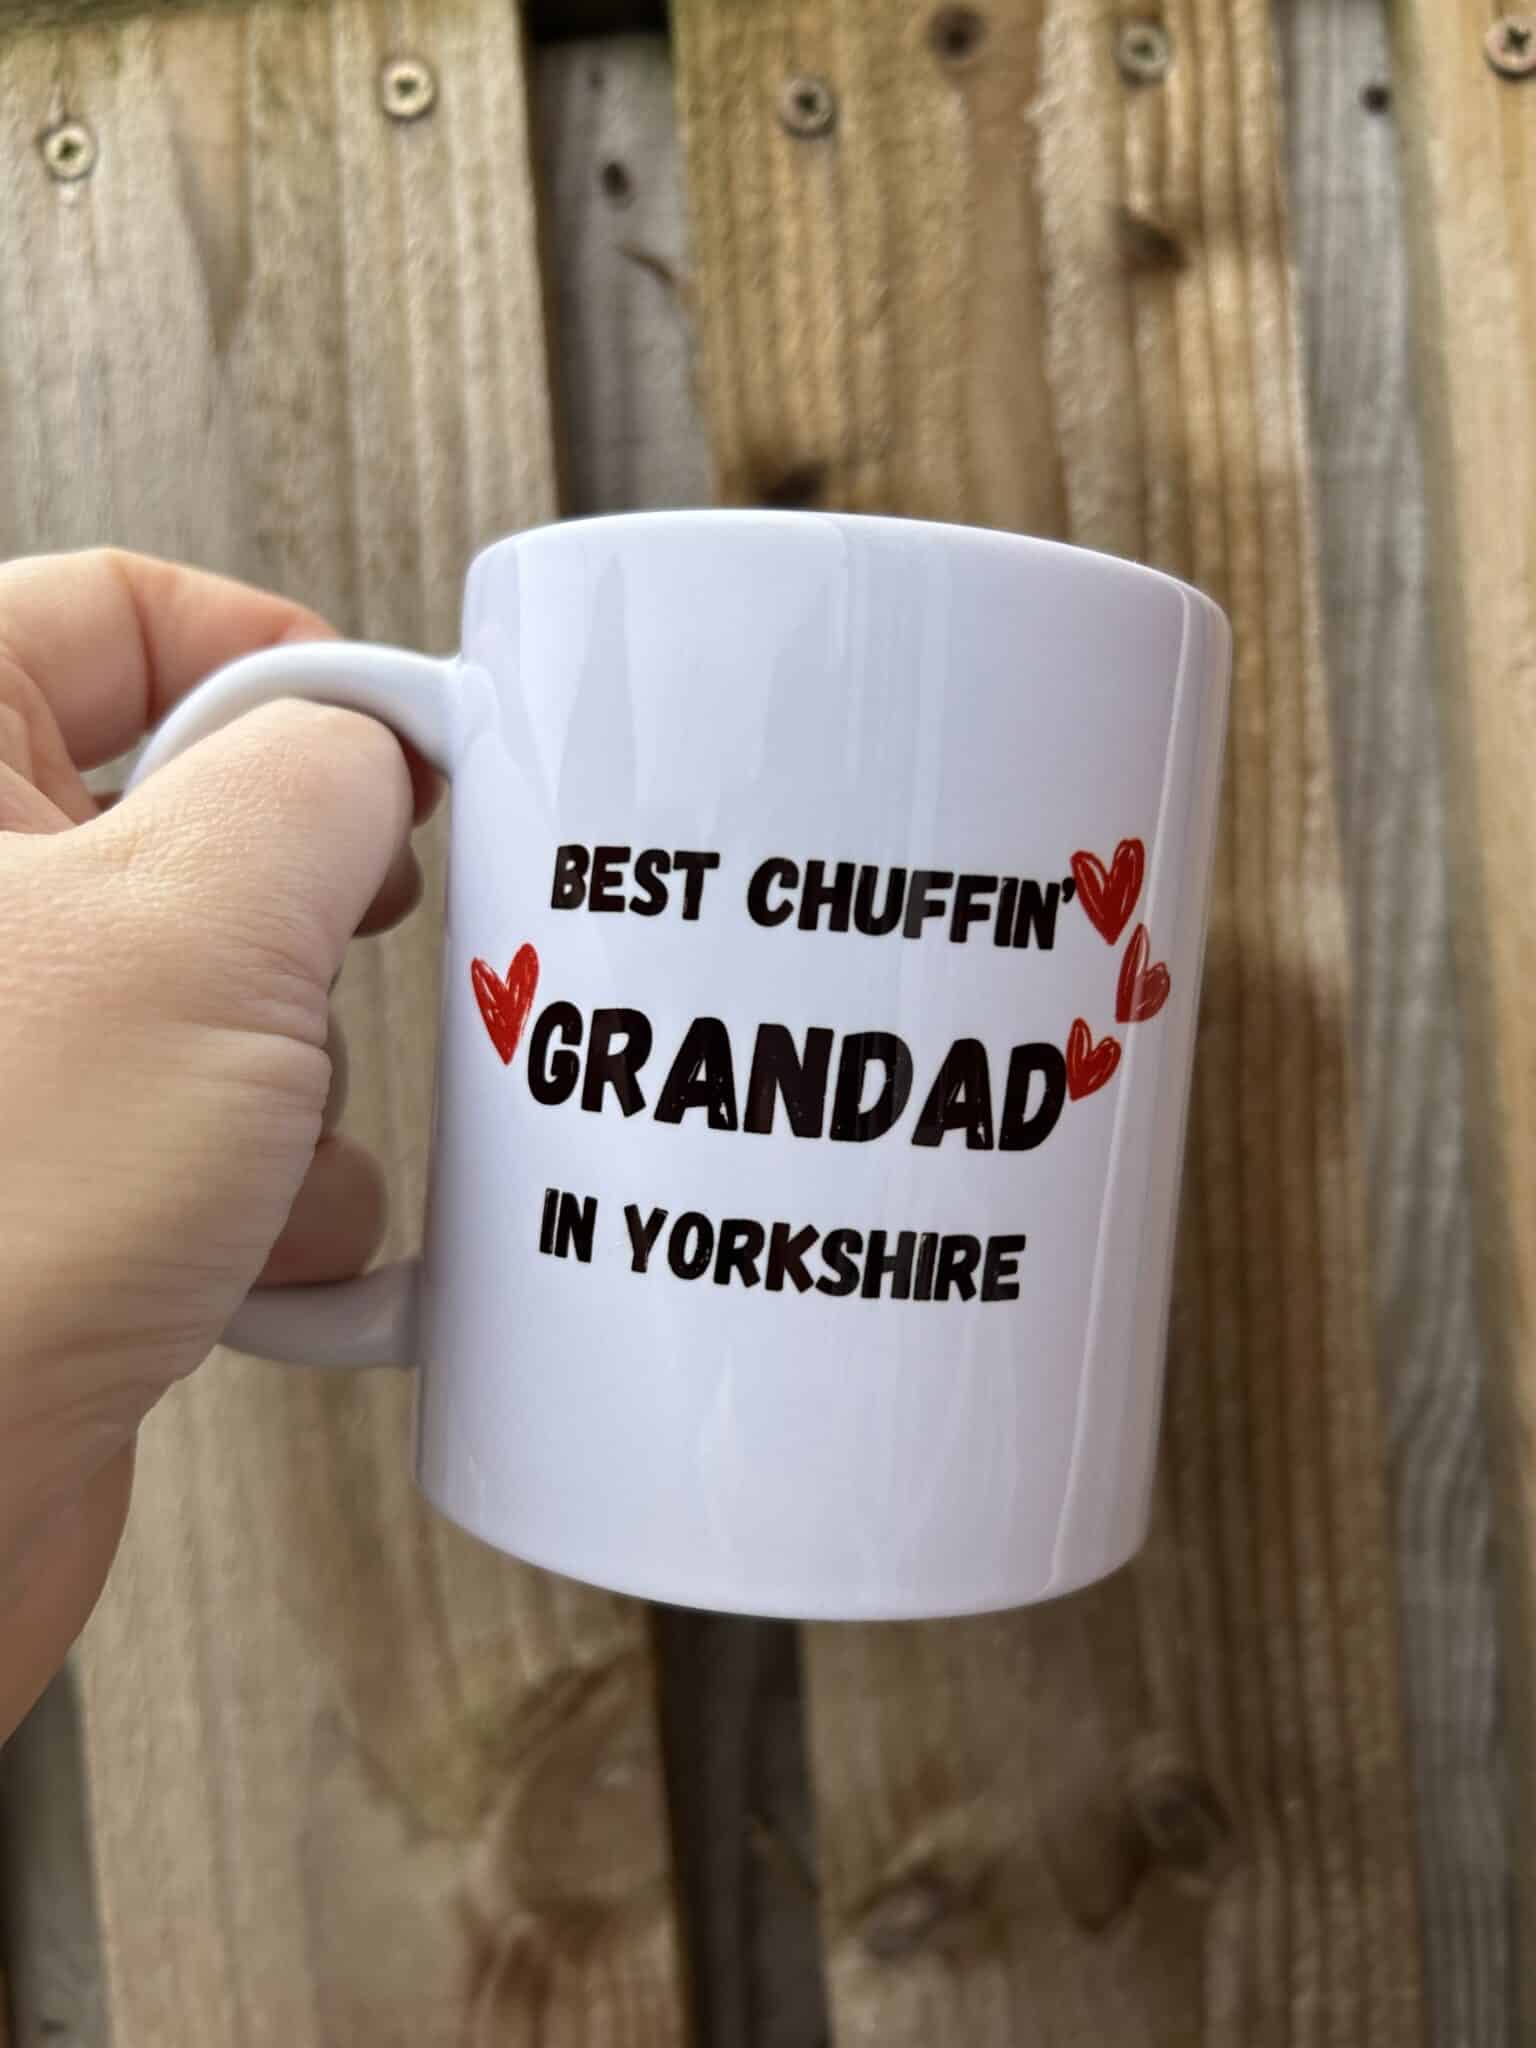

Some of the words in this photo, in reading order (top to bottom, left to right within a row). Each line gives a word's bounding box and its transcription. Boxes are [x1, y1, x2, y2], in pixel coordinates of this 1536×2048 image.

[550, 844, 720, 920] BEST
[527, 1000, 1069, 1152] GRANDAD
[539, 1187, 598, 1264] IN
[623, 1204, 1027, 1303] YORKSHIRE
